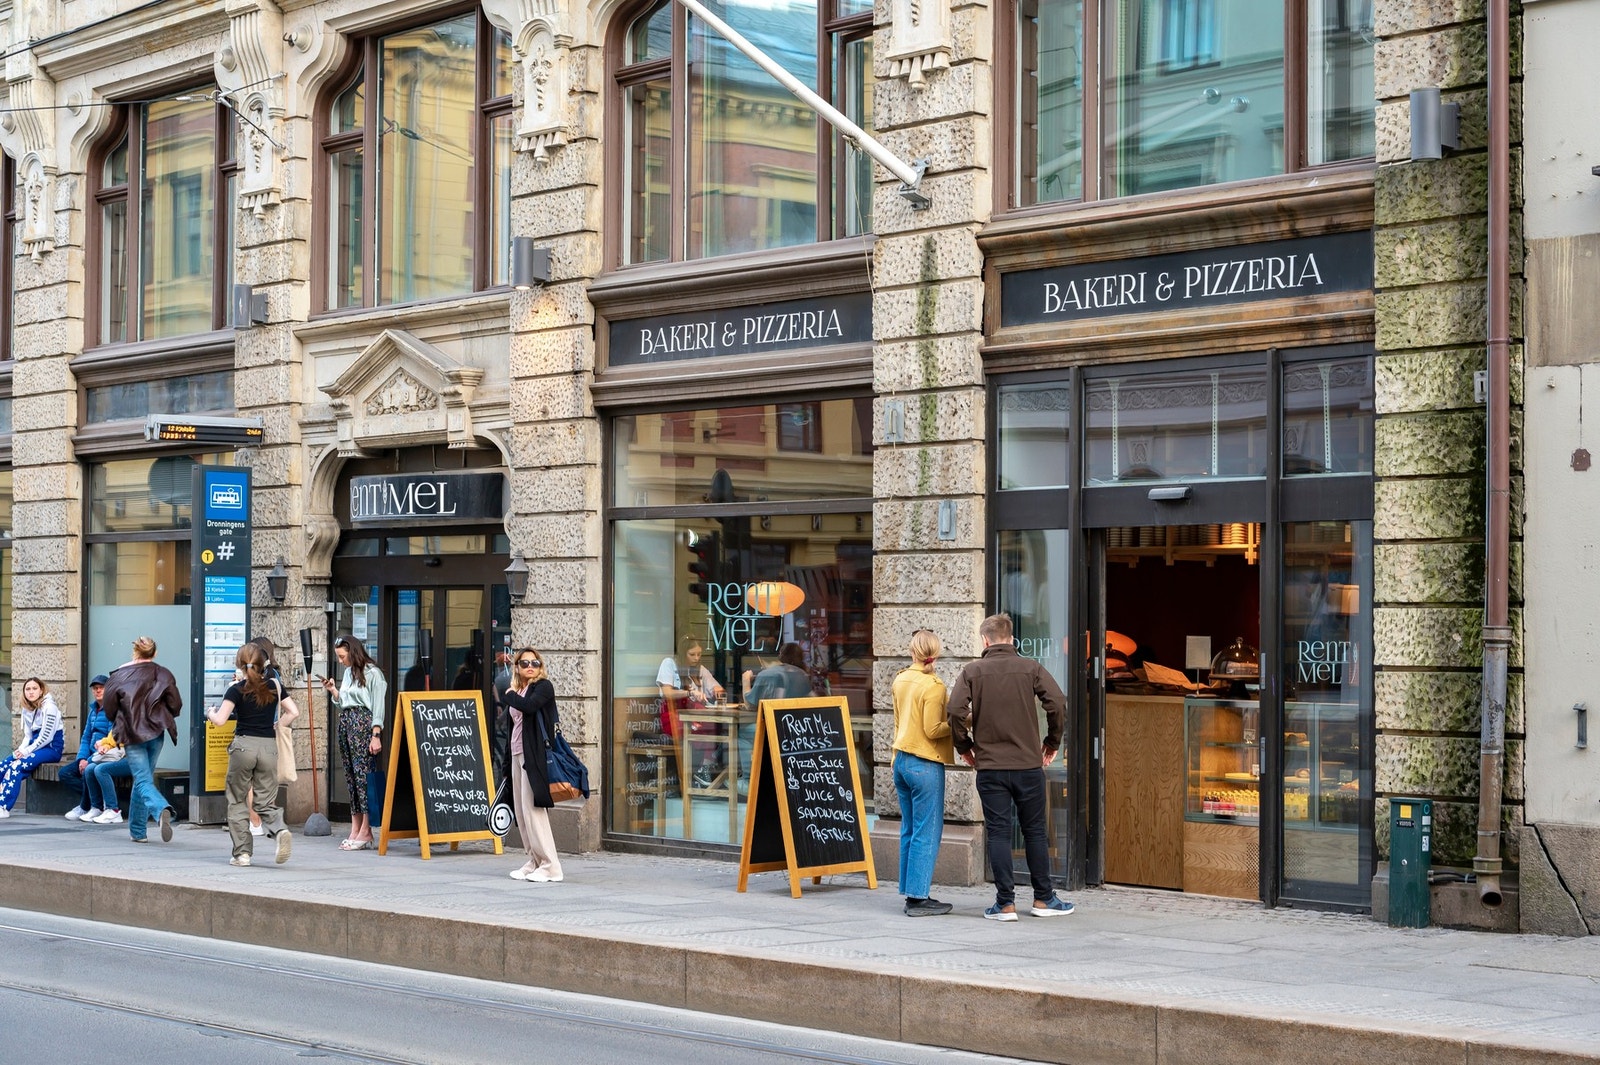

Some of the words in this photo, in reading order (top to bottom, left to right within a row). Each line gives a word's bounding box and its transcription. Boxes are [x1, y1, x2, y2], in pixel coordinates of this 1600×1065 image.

[1043, 271, 1147, 314] BAKERI
[1155, 272, 1176, 301] &
[1183, 253, 1324, 299] PIZZERIA
[640, 321, 716, 356] BAKERI
[722, 322, 737, 347] &
[742, 308, 844, 345] PIZZERIA
[206, 520, 245, 529] Dronningens
[427, 724, 472, 741] ARTISAN
[421, 742, 476, 761] PIZZERIA
[781, 736, 833, 752] EXPRESS
[787, 755, 819, 771] PIZZA
[818, 755, 845, 769] SLICE
[433, 766, 474, 784] BAKERY
[801, 771, 840, 785] COFFEE
[466, 790, 487, 801] 07-22
[804, 788, 835, 801] JUICE
[434, 802, 469, 814] SAT-SUN
[797, 806, 855, 823] SANDWICHES
[806, 823, 854, 844] PASTRIES
